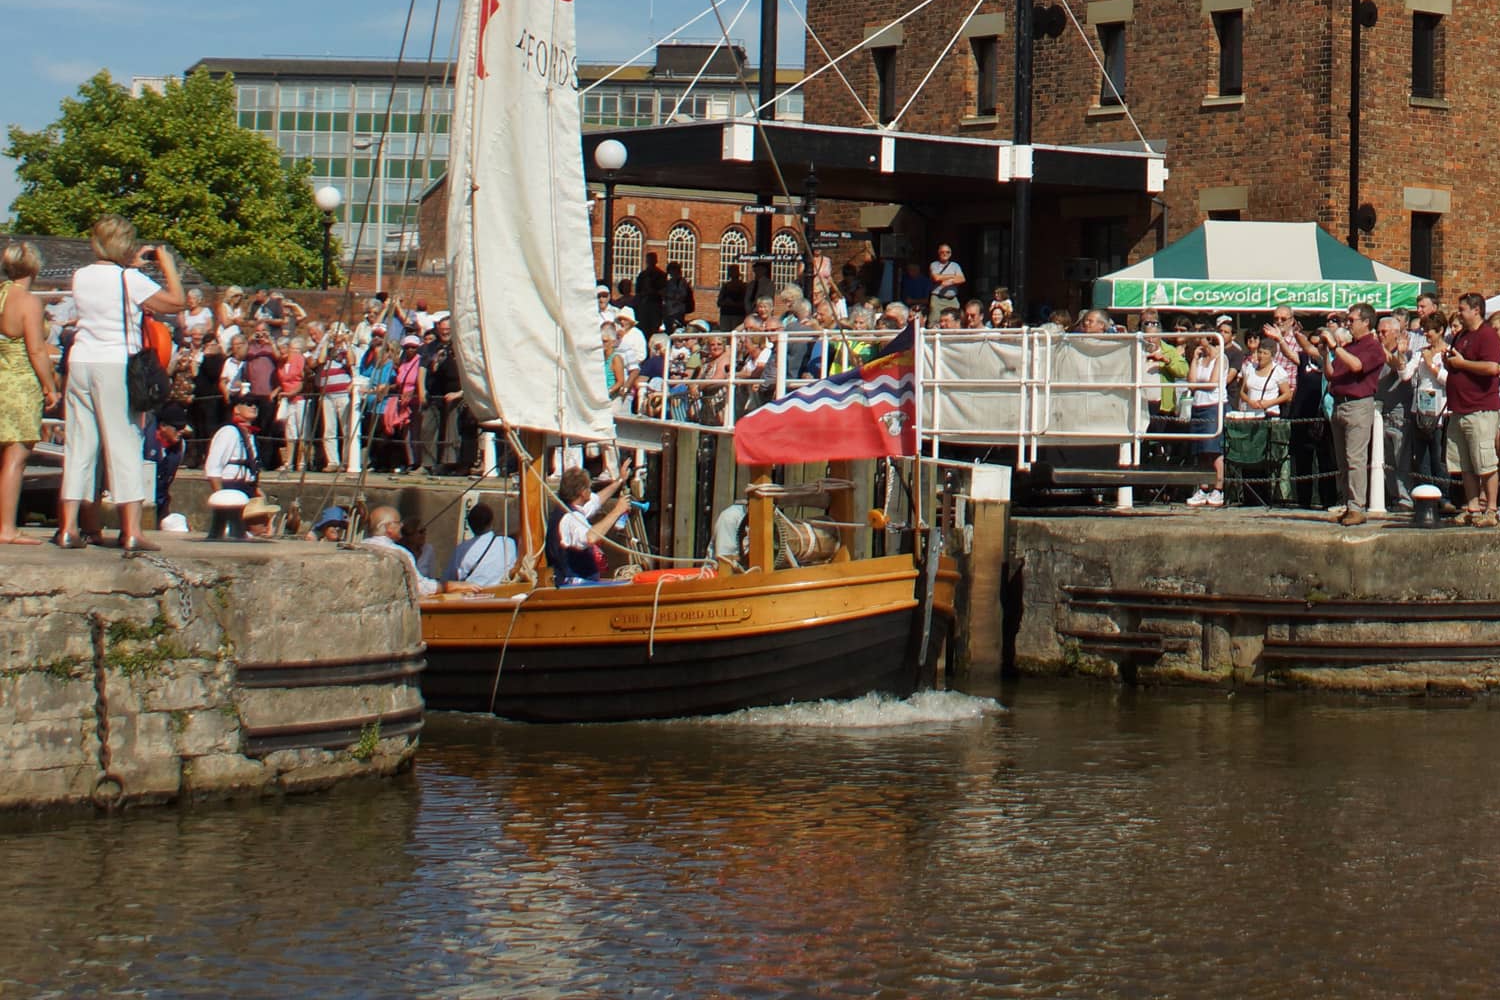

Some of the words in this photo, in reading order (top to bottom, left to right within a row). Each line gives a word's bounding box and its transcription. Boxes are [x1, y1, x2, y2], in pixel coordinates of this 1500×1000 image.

[1178, 286, 1262, 303] Cotswold
[1273, 287, 1329, 303] Canals
[1338, 288, 1382, 304] Trust
[645, 610, 704, 623] HREFORD
[708, 607, 737, 618] BULL
